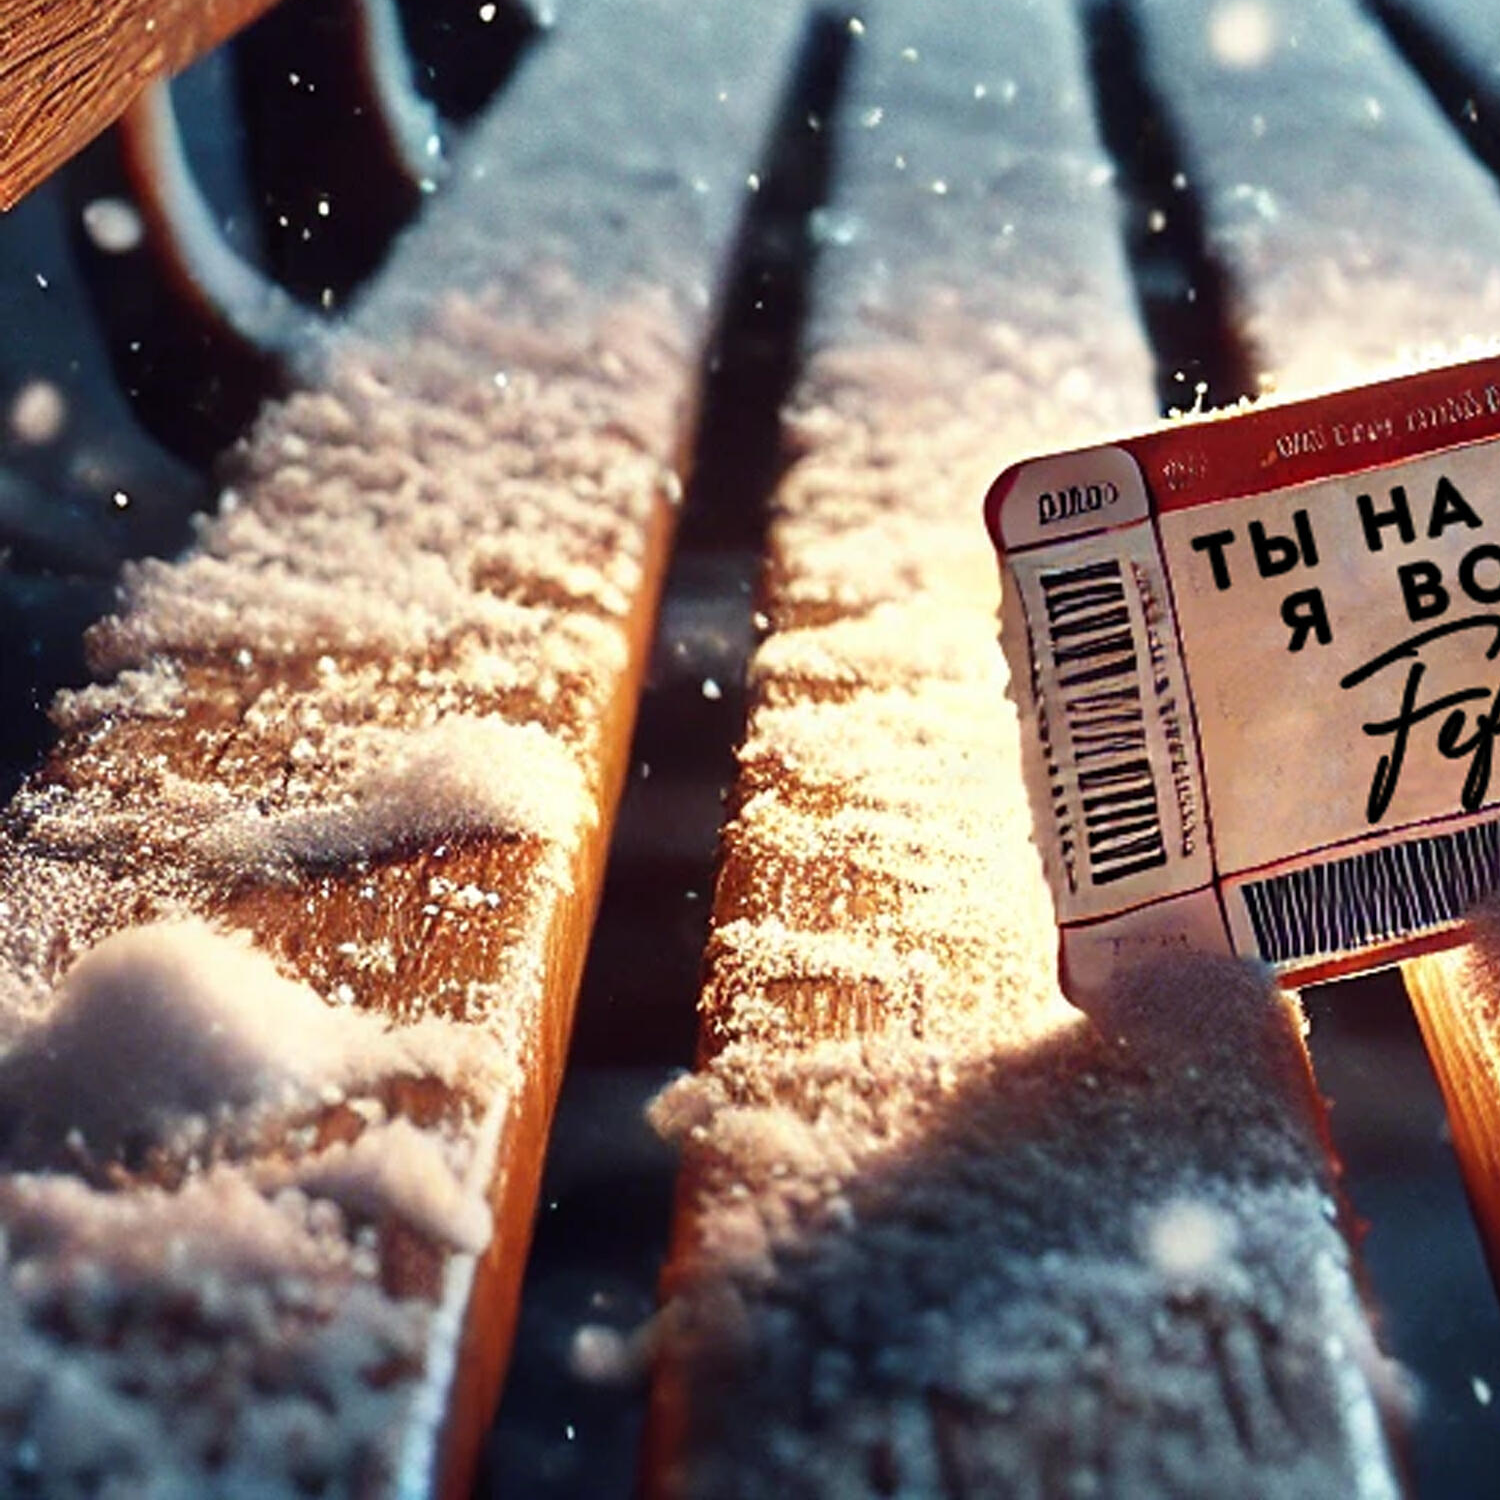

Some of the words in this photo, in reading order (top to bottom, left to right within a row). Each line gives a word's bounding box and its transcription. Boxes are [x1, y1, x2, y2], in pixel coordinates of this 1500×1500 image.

[1191, 509, 1319, 590] ТЫ
[1356, 477, 1483, 552] НА
[1281, 588, 1332, 652] Я
